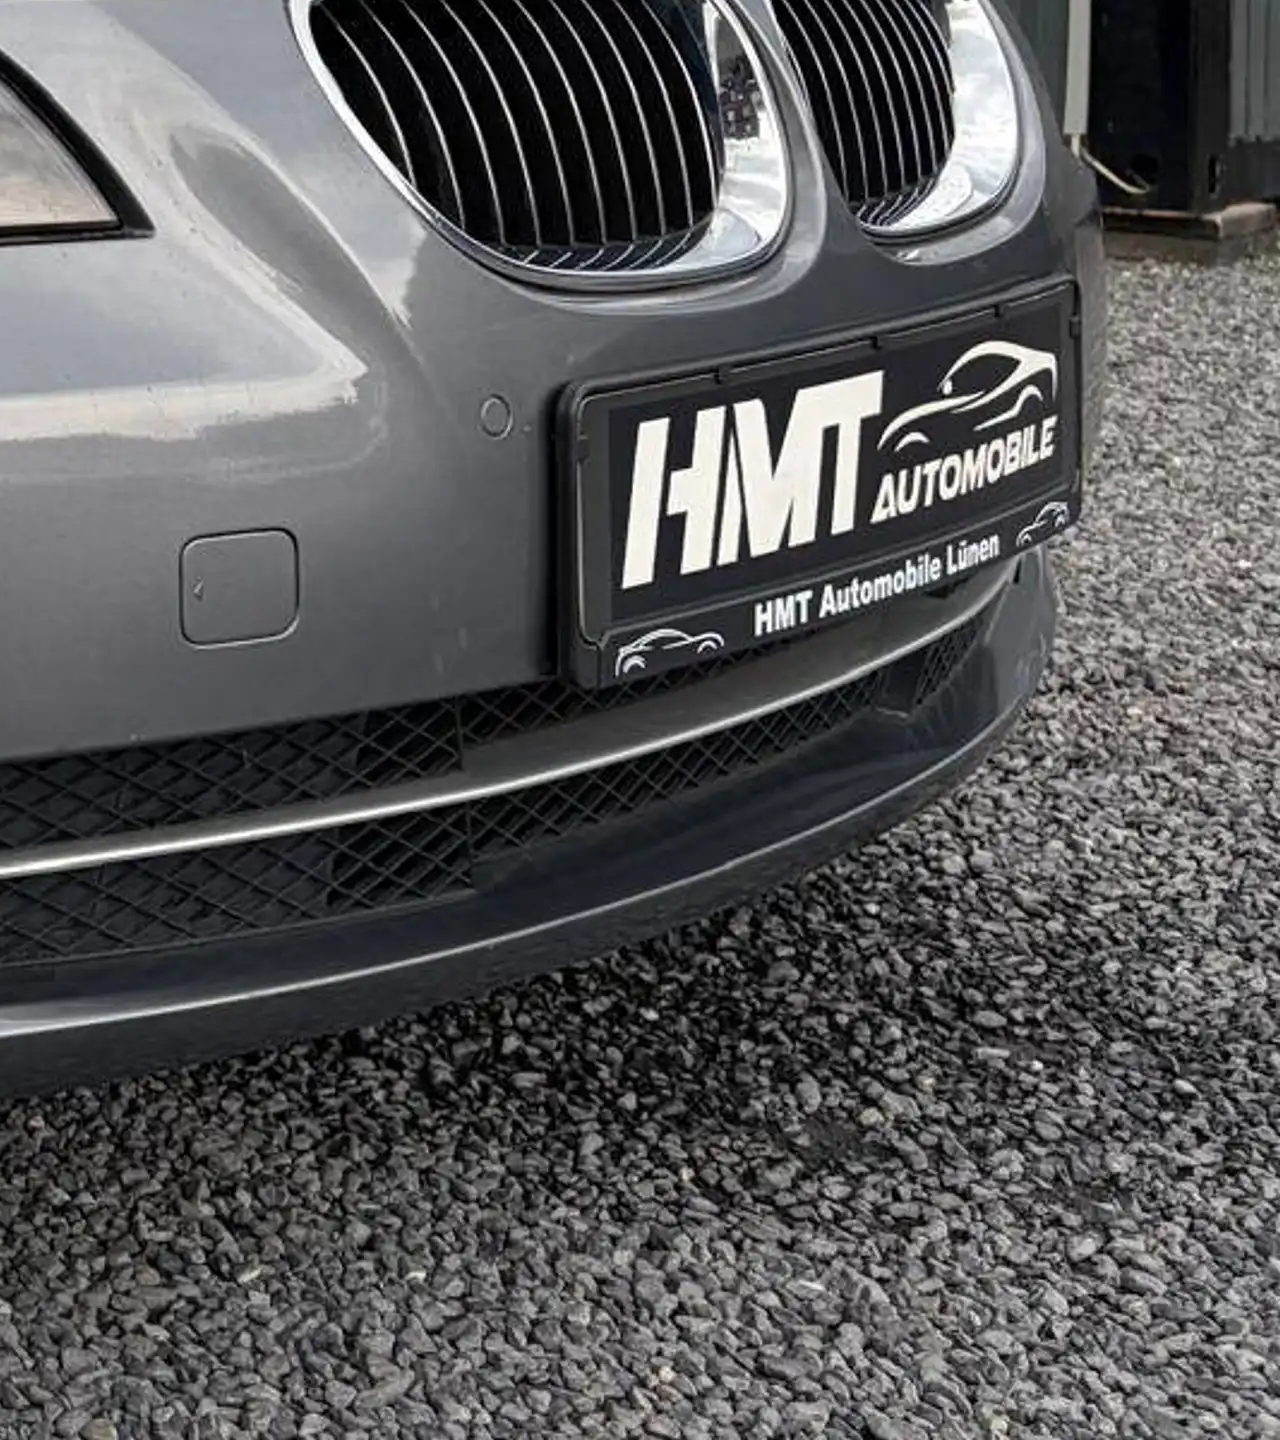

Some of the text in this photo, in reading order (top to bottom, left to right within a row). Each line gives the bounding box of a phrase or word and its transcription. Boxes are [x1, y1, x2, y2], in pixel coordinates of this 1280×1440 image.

[622, 369, 1059, 590] HMT AUTOMOBILE
[754, 533, 1000, 637] HMT Automobile Lünen
